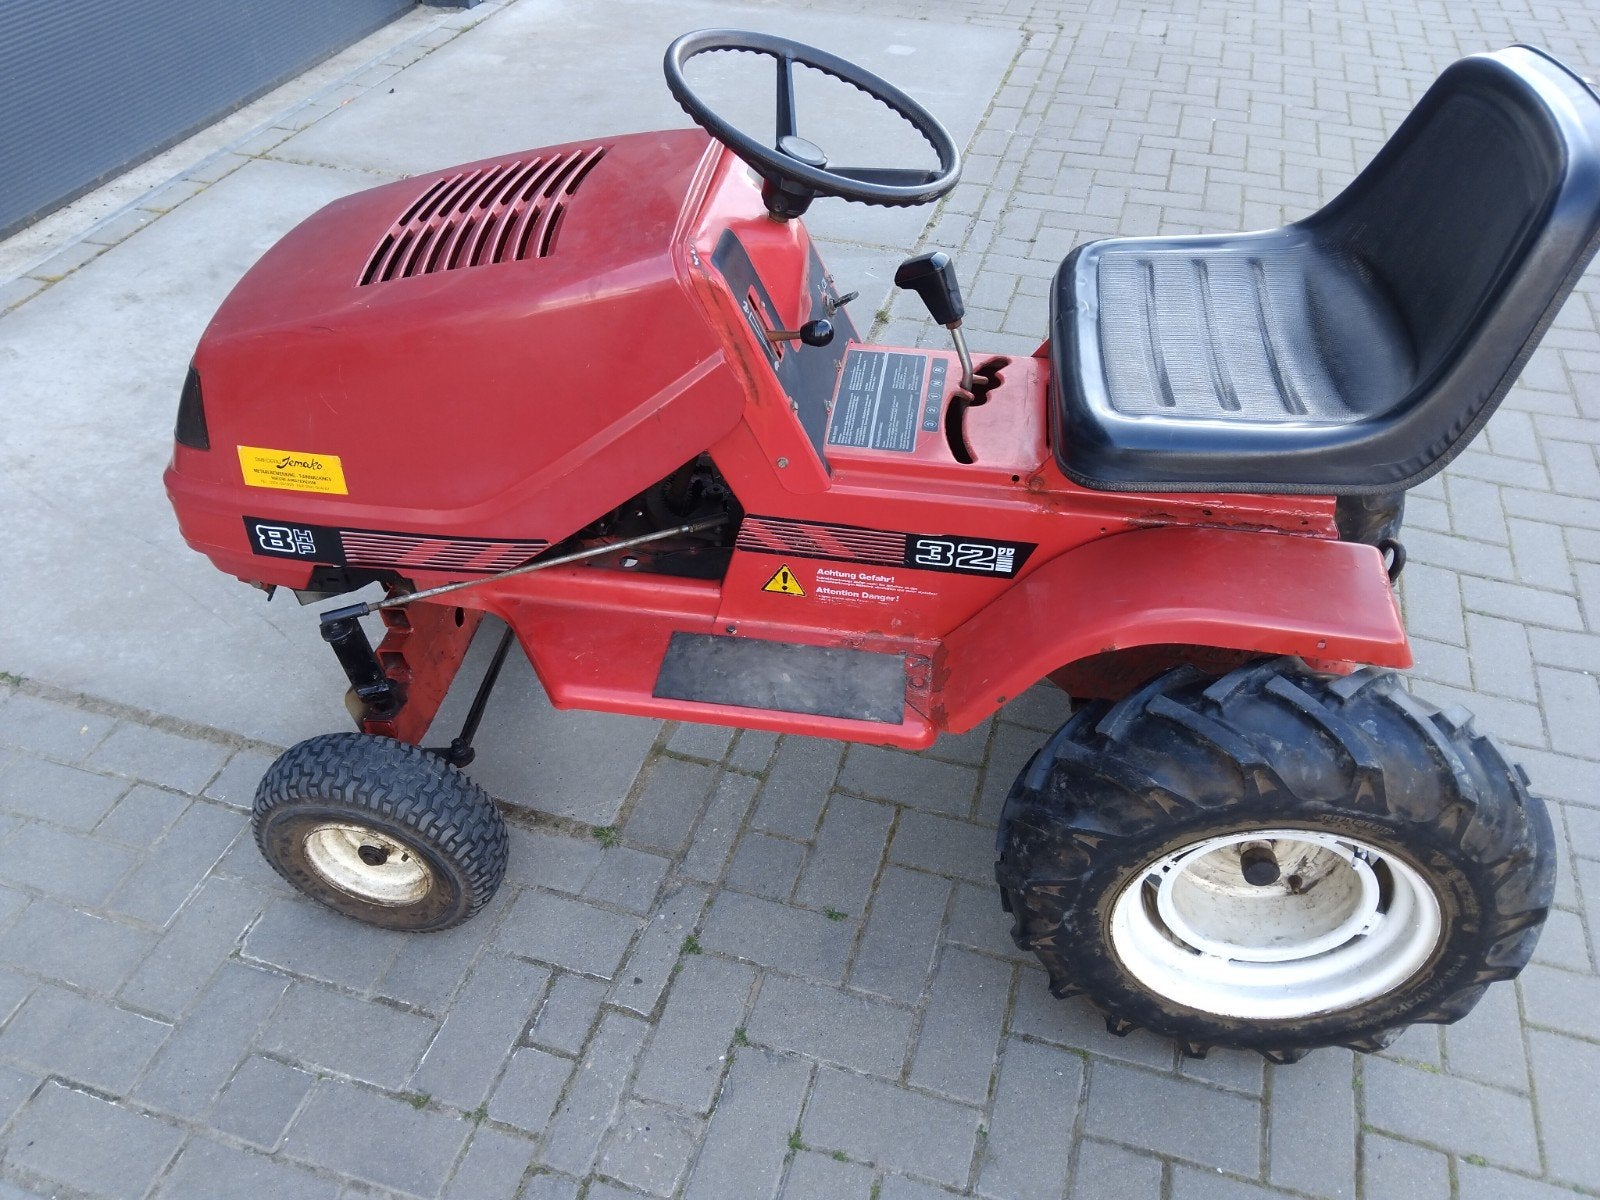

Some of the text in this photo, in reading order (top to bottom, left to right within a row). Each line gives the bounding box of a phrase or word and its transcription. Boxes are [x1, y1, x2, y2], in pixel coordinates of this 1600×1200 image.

[255, 524, 296, 553] 8
[816, 568, 856, 580] Achtung
[858, 573, 895, 583] Gefahr!
[815, 586, 859, 598] Attention
[861, 591, 900, 602] Danger!
